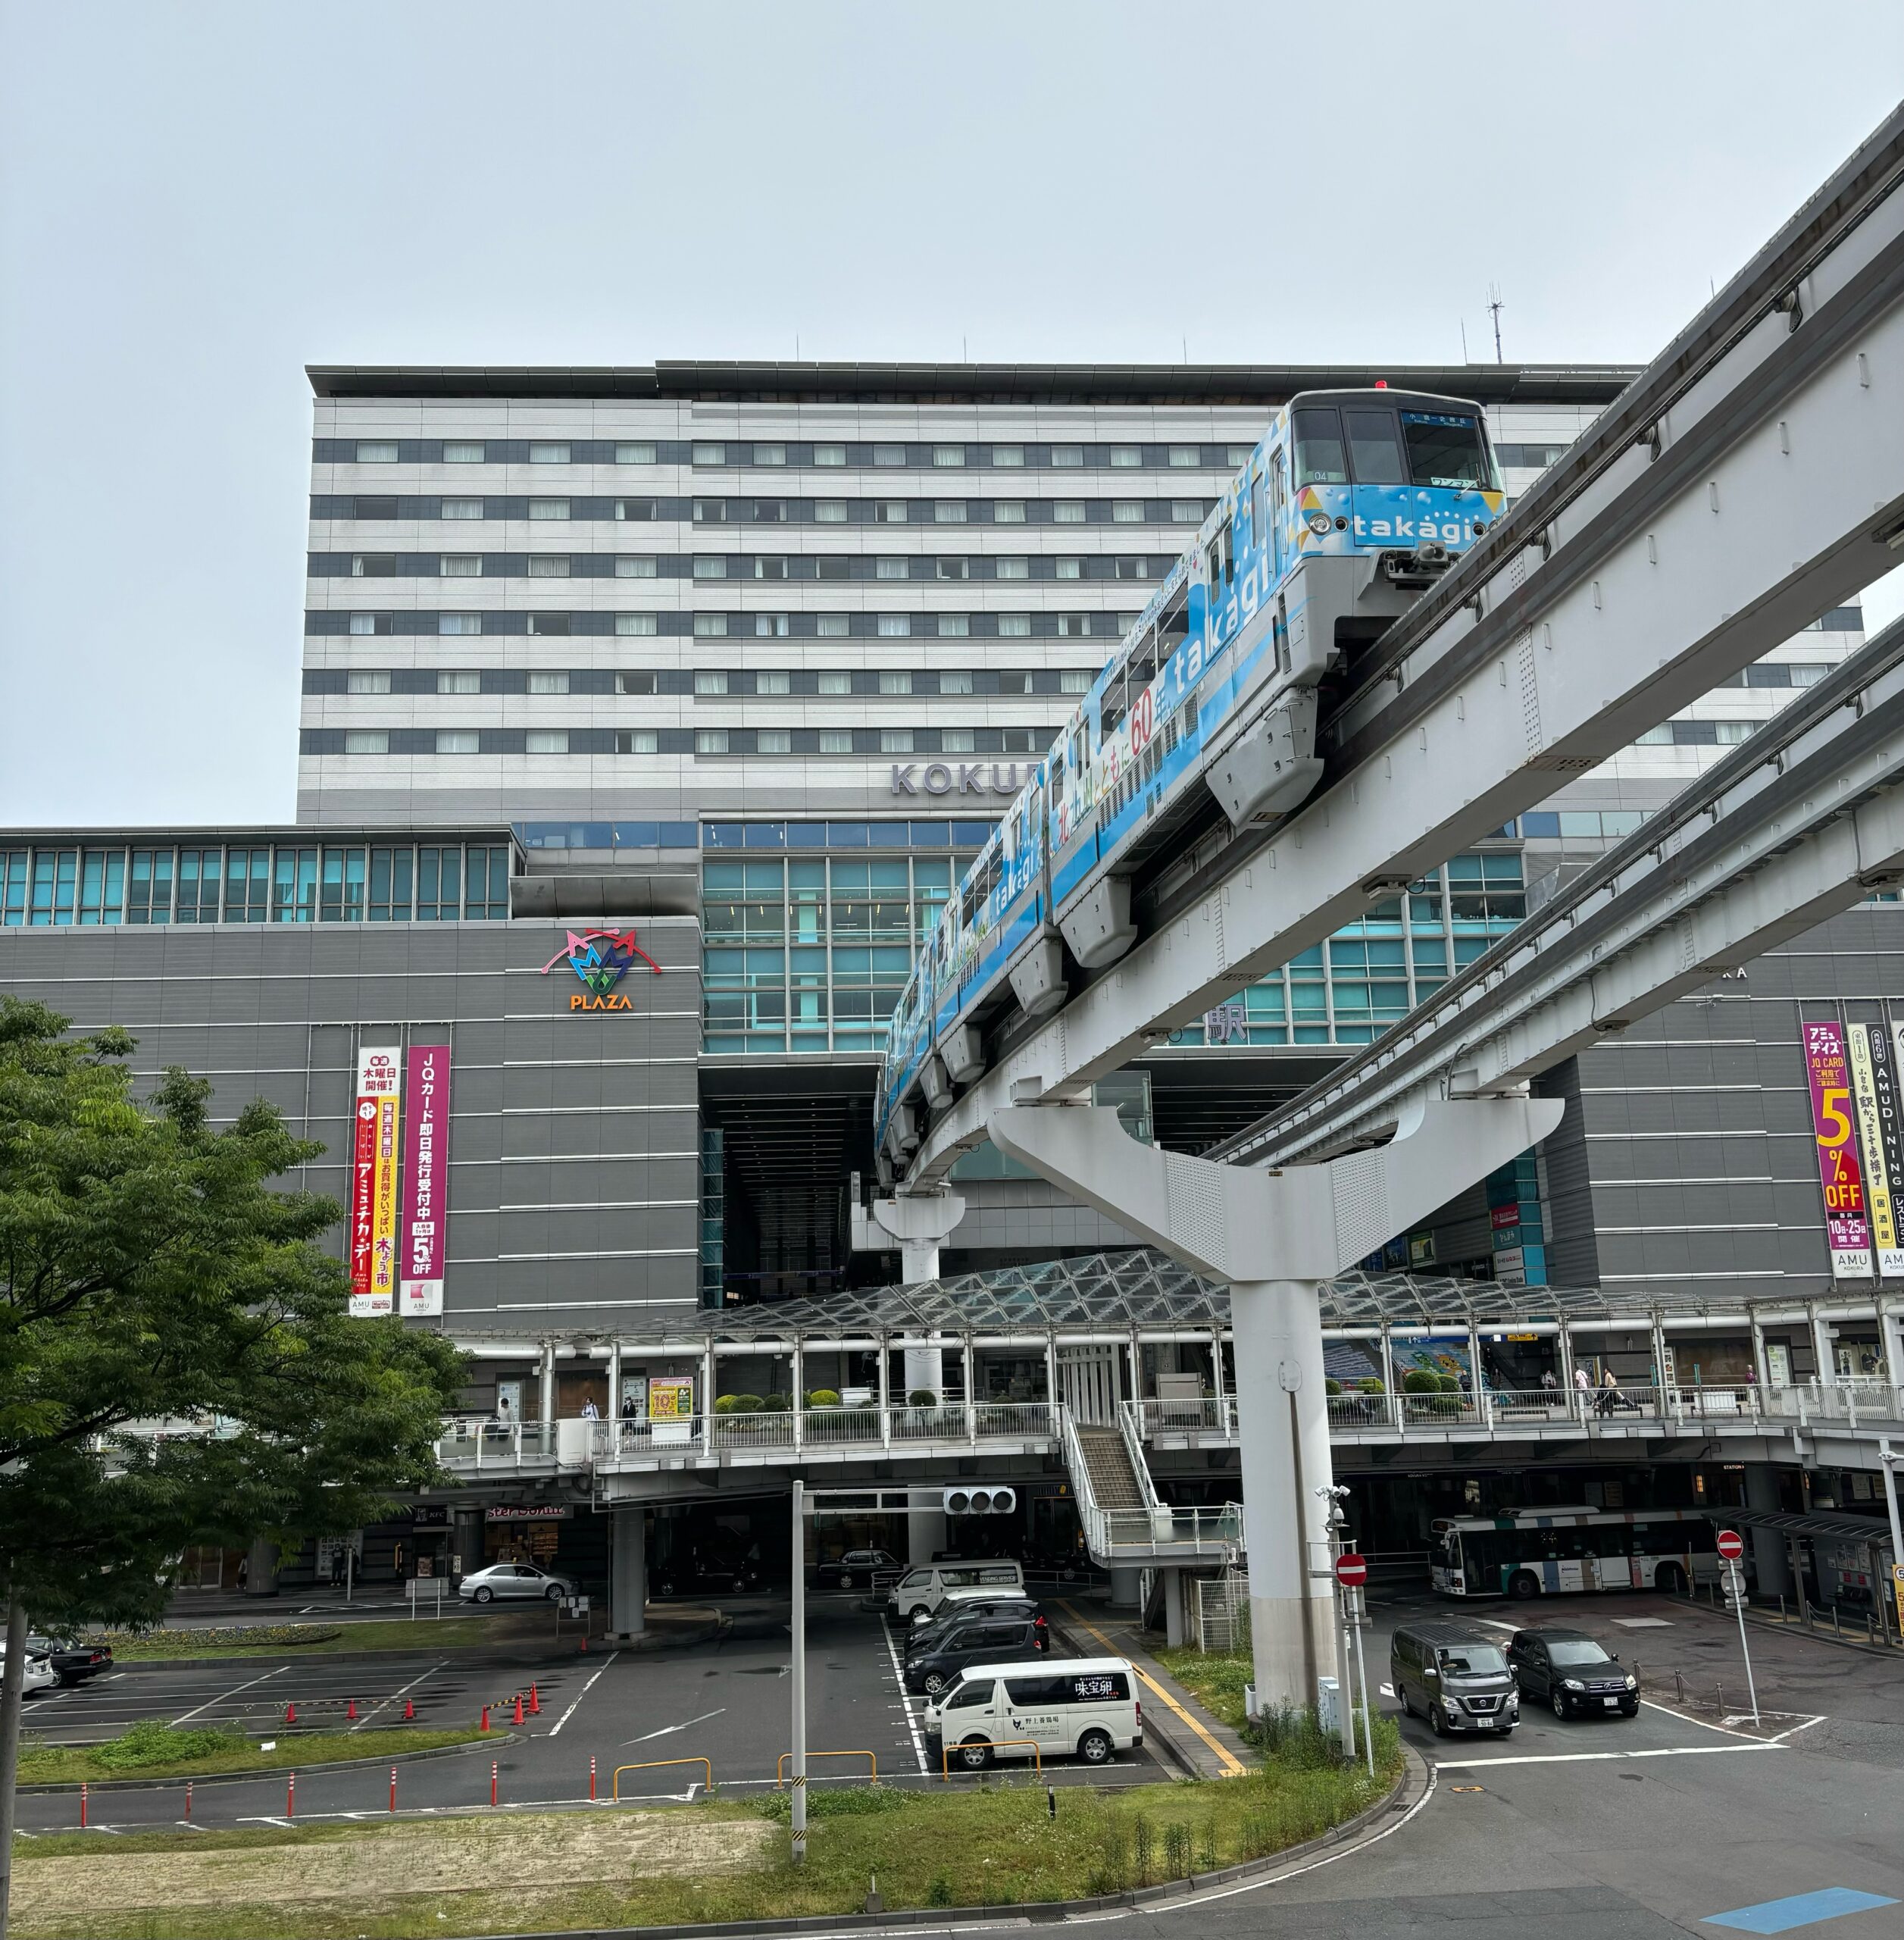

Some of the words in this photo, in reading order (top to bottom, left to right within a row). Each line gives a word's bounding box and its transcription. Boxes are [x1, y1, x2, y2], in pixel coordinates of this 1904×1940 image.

[1352, 514, 1471, 543] takagi
[1174, 543, 1271, 694] takagi
[571, 994, 633, 1010] PLAZA
[1809, 1027, 1835, 1040] アミュ
[1809, 1040, 1842, 1054] デイズ
[1811, 1058, 1821, 1068] JQ
[1823, 1057, 1844, 1067] CARD
[363, 1068, 396, 1078] 木曜日
[1825, 1184, 1860, 1207] OFF
[1838, 1254, 1868, 1266] AMU
[413, 1263, 432, 1275] OFF
[1075, 1680, 1112, 1696] 味宝卵
